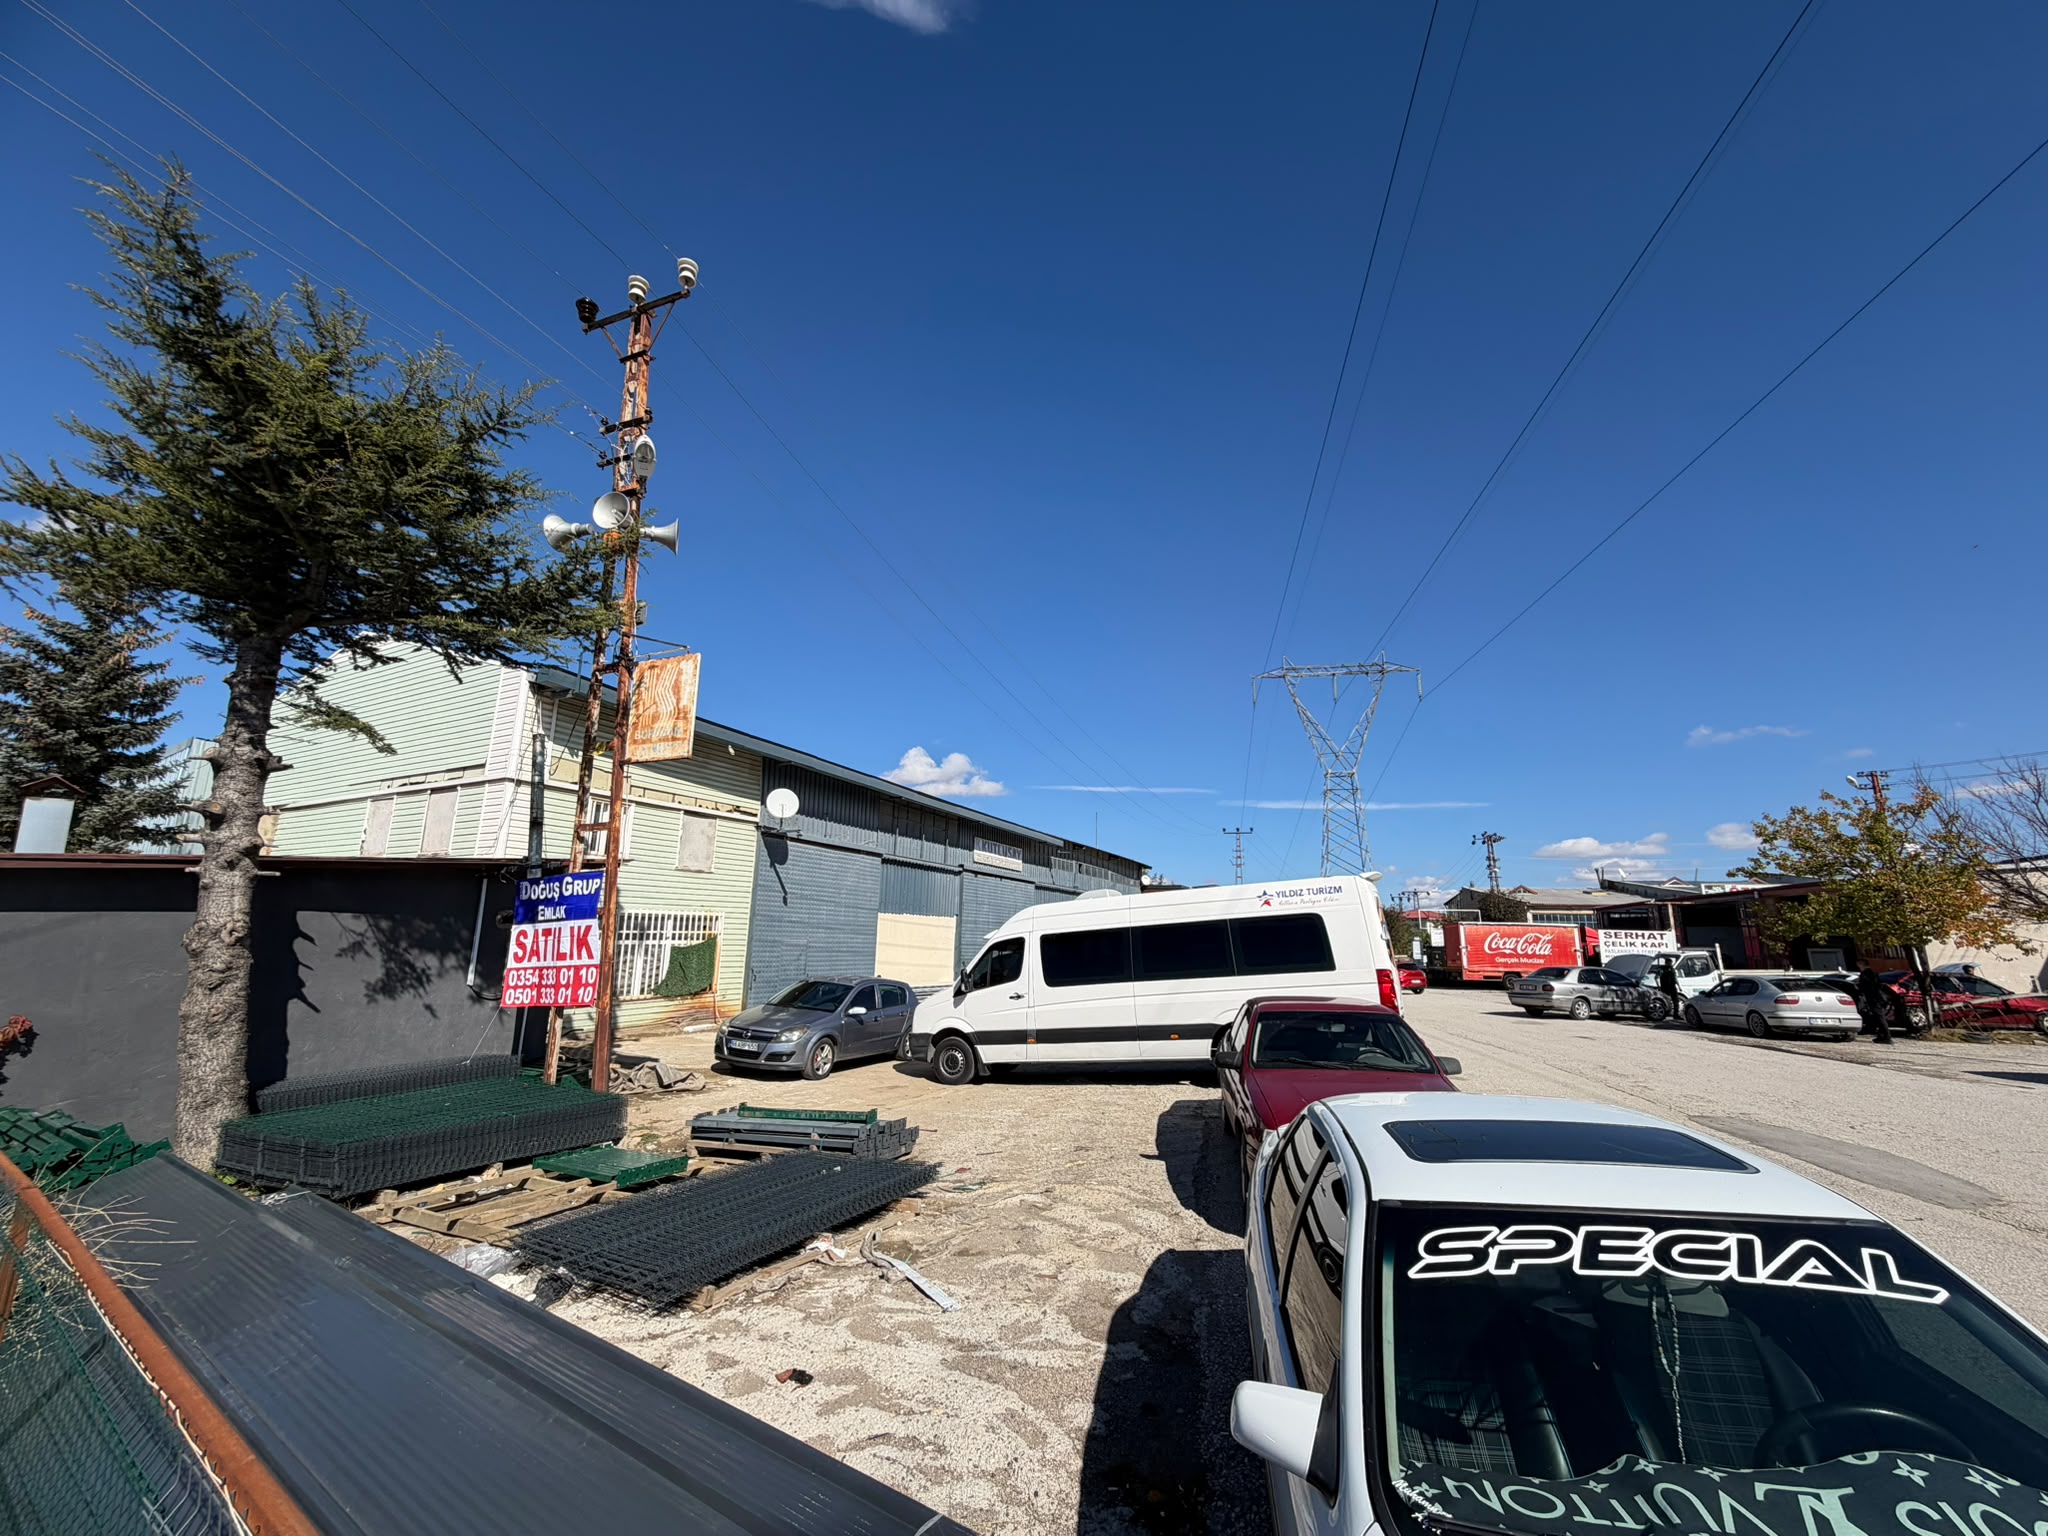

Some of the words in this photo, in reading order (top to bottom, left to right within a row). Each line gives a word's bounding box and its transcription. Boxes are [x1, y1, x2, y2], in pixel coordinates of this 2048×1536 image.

[562, 876, 601, 896] GRUP
[1275, 889, 1304, 898] YILDIZ
[1306, 885, 1343, 896] TURİZM
[513, 925, 595, 964] SATILIK
[1603, 931, 1667, 940] SERHAT
[508, 968, 539, 986] 0354
[541, 968, 557, 985] 333
[560, 967, 575, 985] 01
[580, 966, 597, 984] 10
[505, 987, 537, 1005] 0501
[540, 987, 555, 1004] 333
[558, 986, 572, 1004] 01
[578, 986, 594, 1003] 10
[1407, 1225, 1950, 1304] SPECIAL
